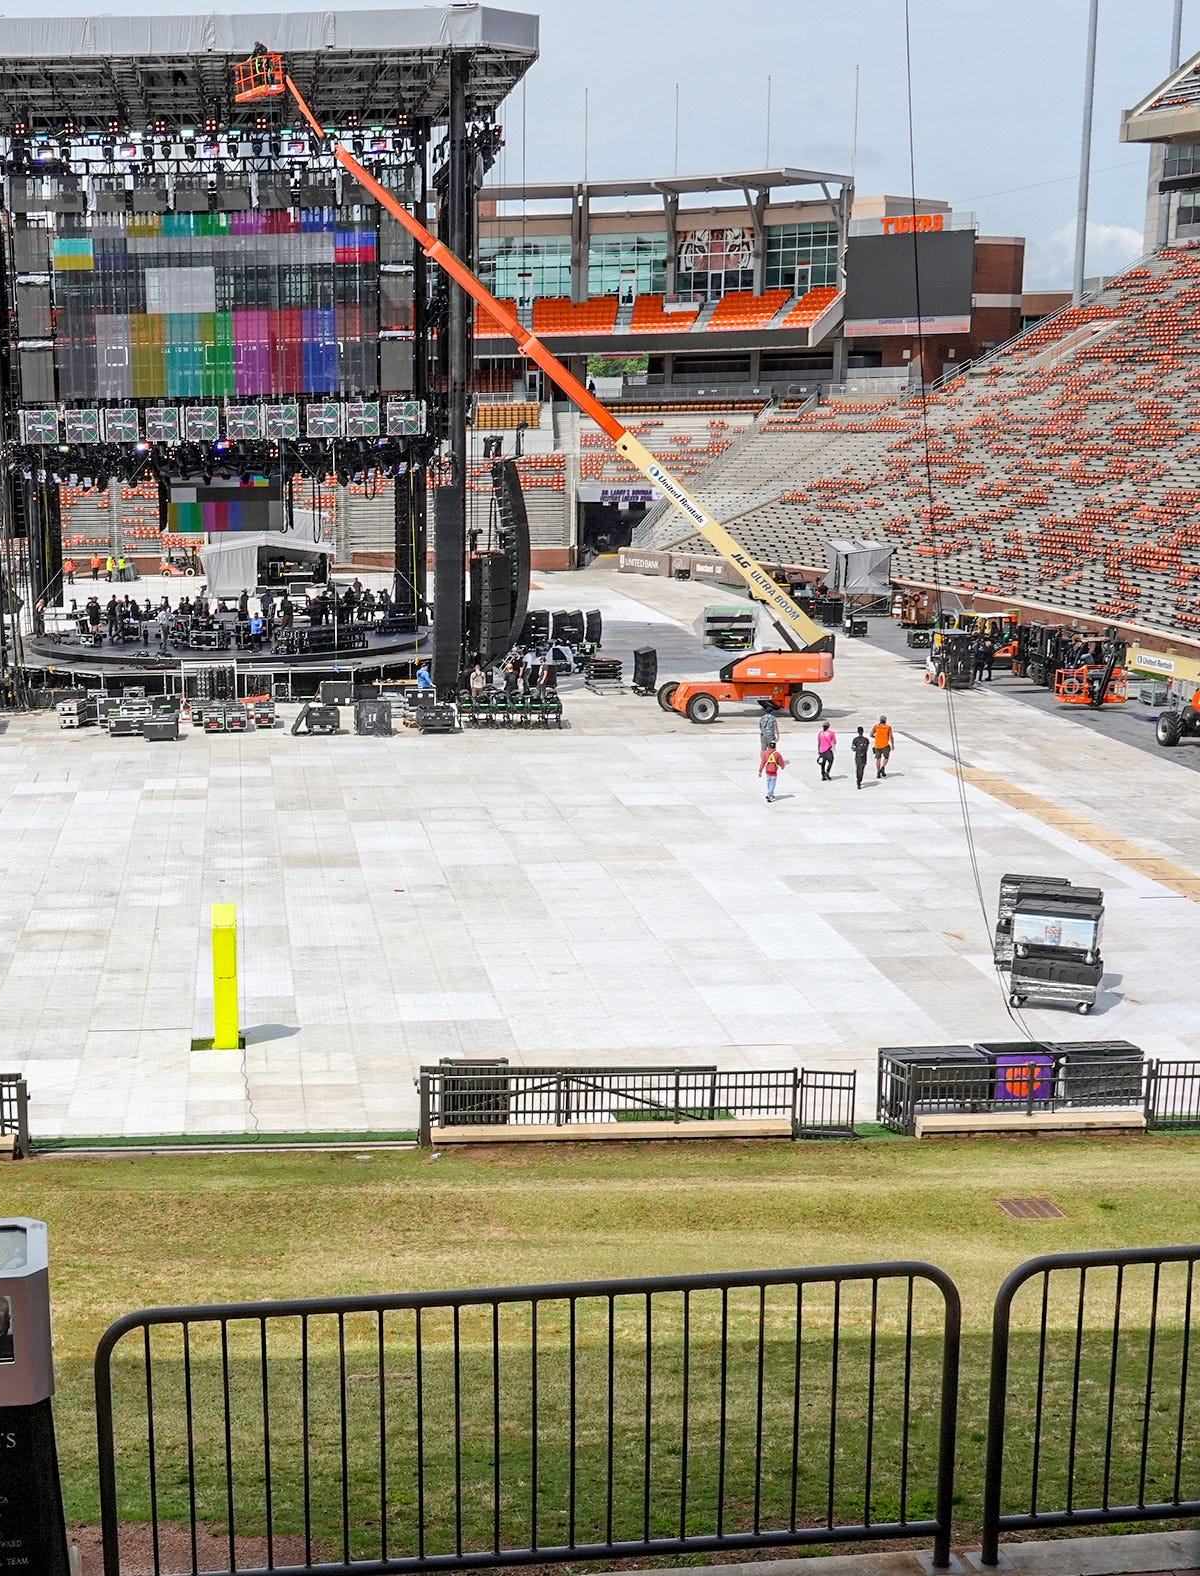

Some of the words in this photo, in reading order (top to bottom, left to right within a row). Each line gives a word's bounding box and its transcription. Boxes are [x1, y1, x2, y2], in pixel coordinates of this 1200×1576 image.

[881, 214, 944, 234] TIGERS
[658, 475, 682, 499] United
[679, 497, 704, 523] Rentals
[625, 557, 645, 568] UNITED
[644, 558, 659, 569] BANK
[731, 553, 751, 569] JLG
[750, 569, 776, 597] ULTRA
[774, 595, 800, 620] BOOM
[1142, 656, 1157, 666] United
[1156, 659, 1173, 670] Rentals
[6, 1557, 29, 1565] TEAM
